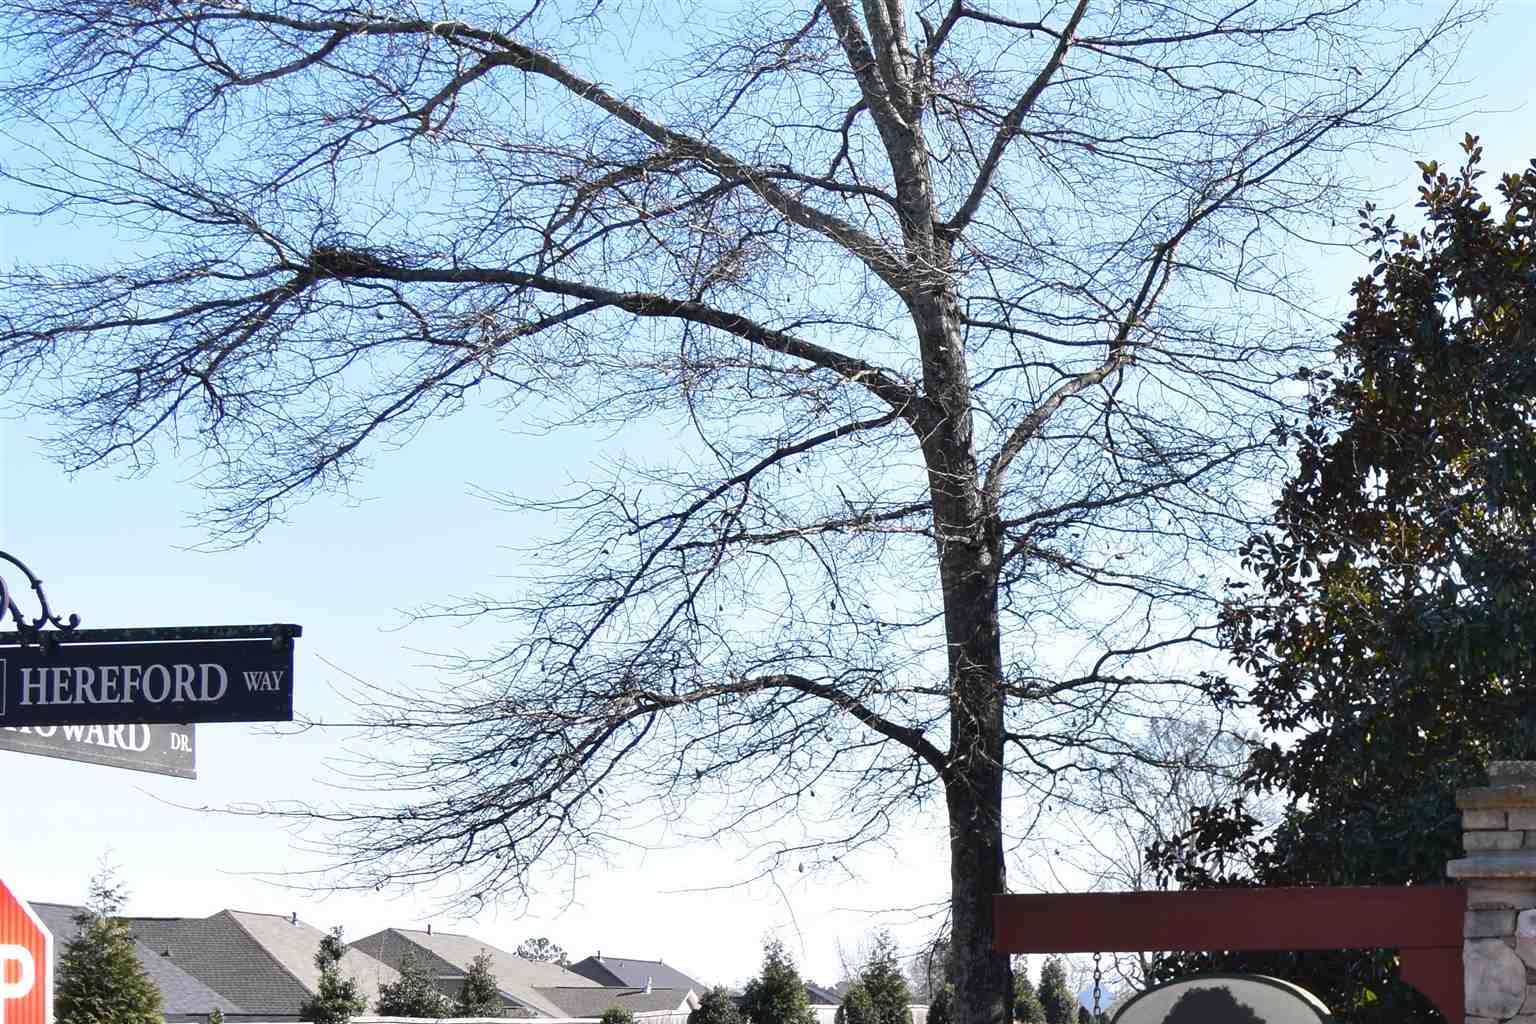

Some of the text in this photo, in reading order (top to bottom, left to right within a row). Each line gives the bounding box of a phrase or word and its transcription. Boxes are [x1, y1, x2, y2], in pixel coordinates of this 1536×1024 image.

[19, 663, 285, 705] HEREFORD WAY
[4, 723, 151, 752] WARD
